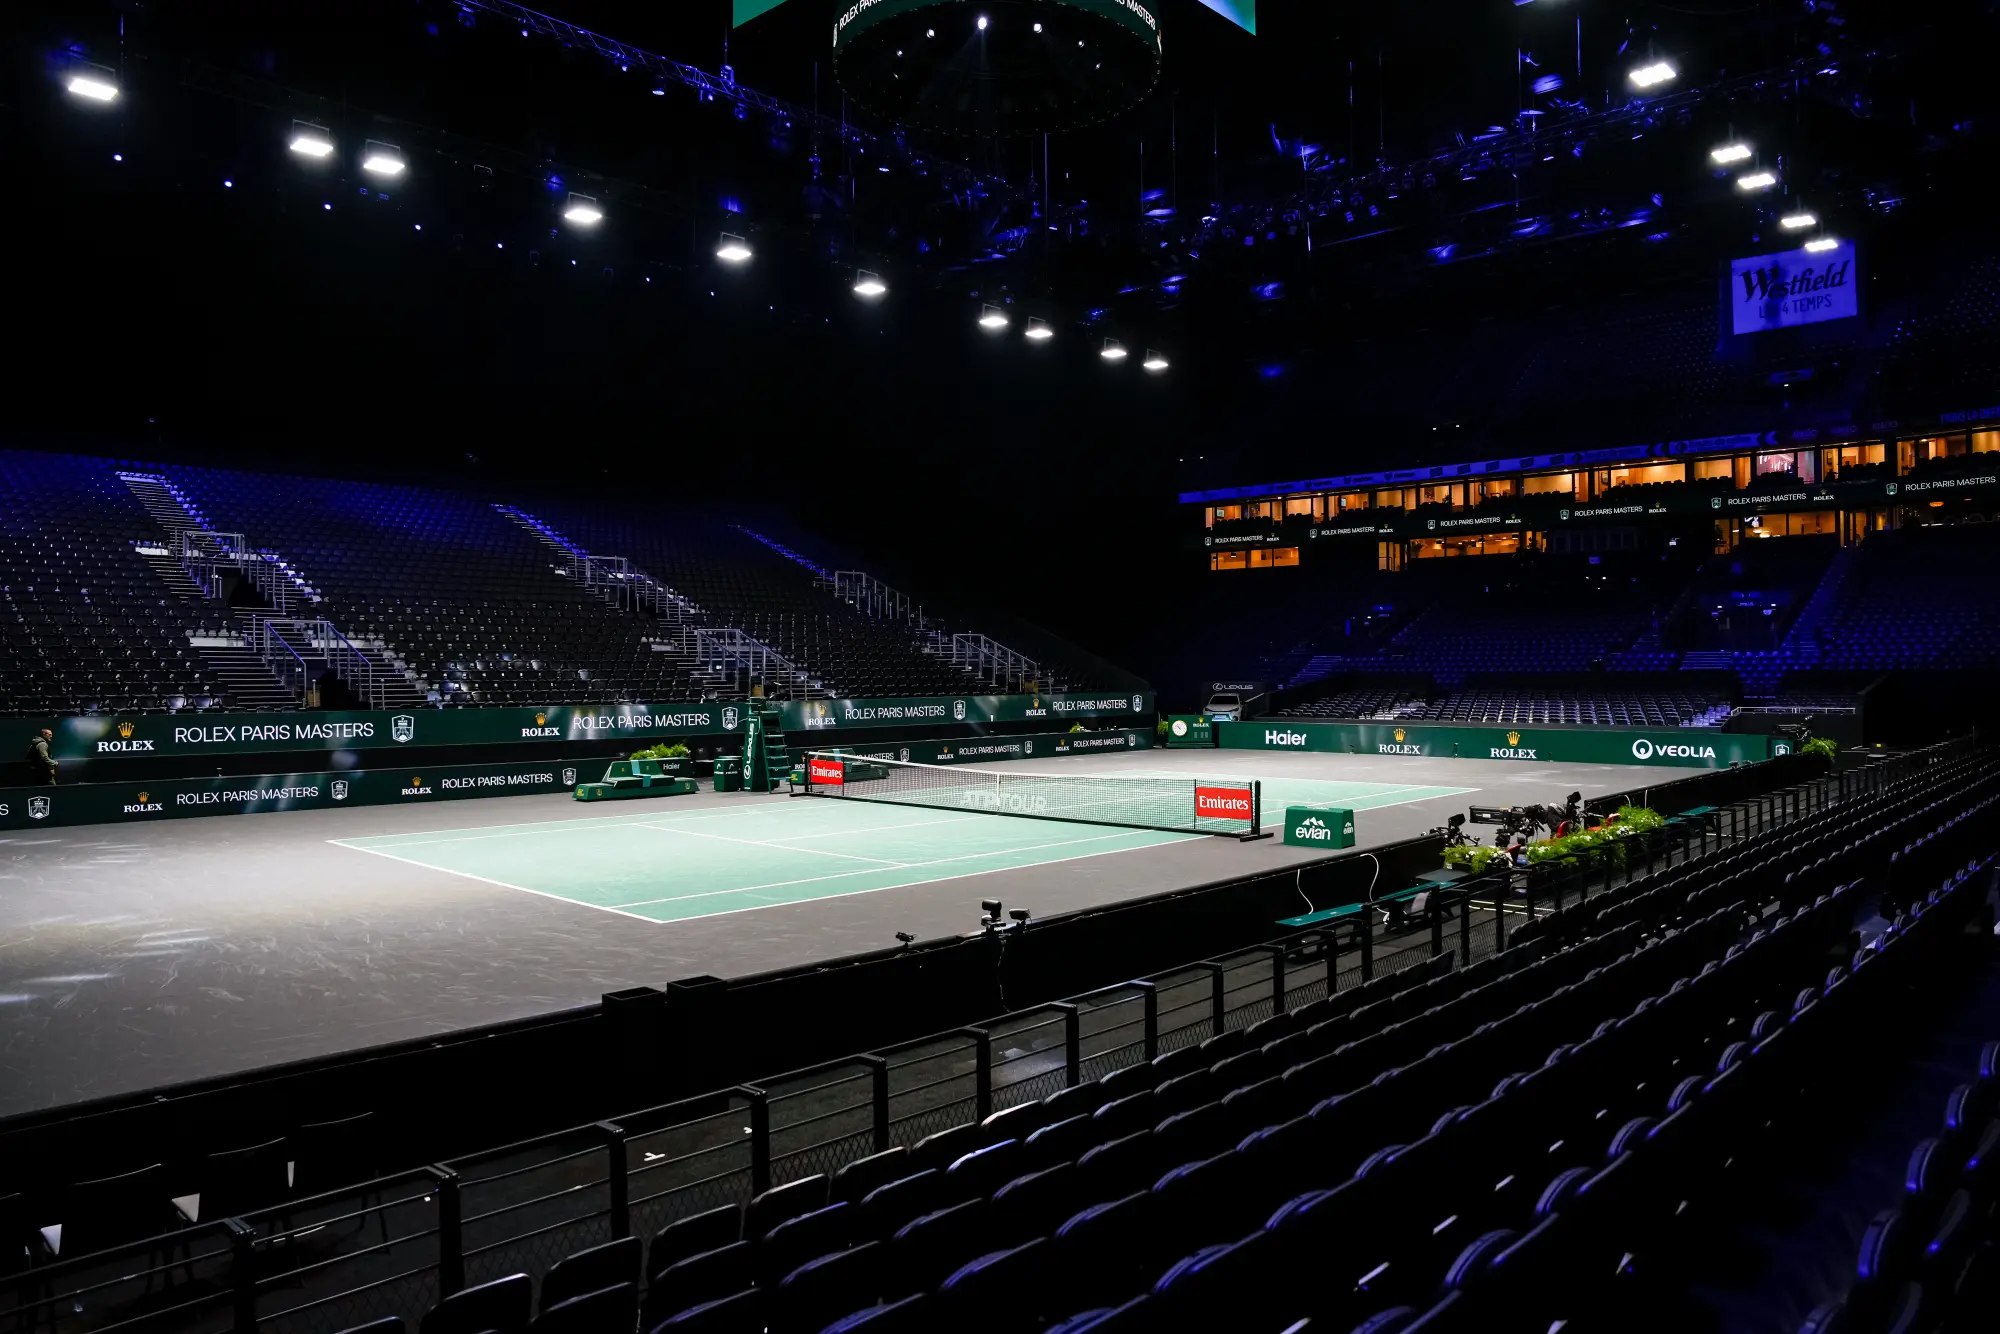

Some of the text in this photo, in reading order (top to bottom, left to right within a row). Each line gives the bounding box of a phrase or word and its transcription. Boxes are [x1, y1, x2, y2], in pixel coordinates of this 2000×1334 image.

[840, 3, 858, 30] ROLEX
[1739, 260, 1850, 302] Westfield
[1792, 294, 1832, 314] TEMPS
[1906, 476, 1996, 491] ROLEX PARIS MASTERS
[1773, 494, 1806, 502] MASTERS
[1614, 506, 1643, 514] MASTERS
[1053, 699, 1127, 711] ROLEX PARIS MASTERS
[845, 706, 945, 720] ROLEX PARIS MASTERS
[573, 713, 710, 729] ROLEX PARIS MASTERS
[808, 717, 836, 726] ROLEX
[175, 723, 374, 742] ROLEX PARIS MASTERS
[521, 728, 560, 737] ROLEX
[1265, 730, 1306, 746] Haier
[97, 740, 154, 752] ROLEX
[995, 745, 1019, 753] MASTERS
[1074, 738, 1124, 748] ROLEX PARIS MASTERS
[1379, 744, 1420, 754] ROLEX
[1490, 748, 1537, 759] ROLEX
[1655, 745, 1716, 758] VEOLIA
[812, 766, 842, 778] Emirates
[442, 773, 553, 789] ROLEX PARIS MASTERS
[177, 787, 318, 805] ROLEX PARIS MASTERS
[402, 787, 432, 795] ROLEX
[124, 803, 163, 812] ROLEX
[1199, 796, 1248, 810] Emirates
[1296, 826, 1330, 840] evian
